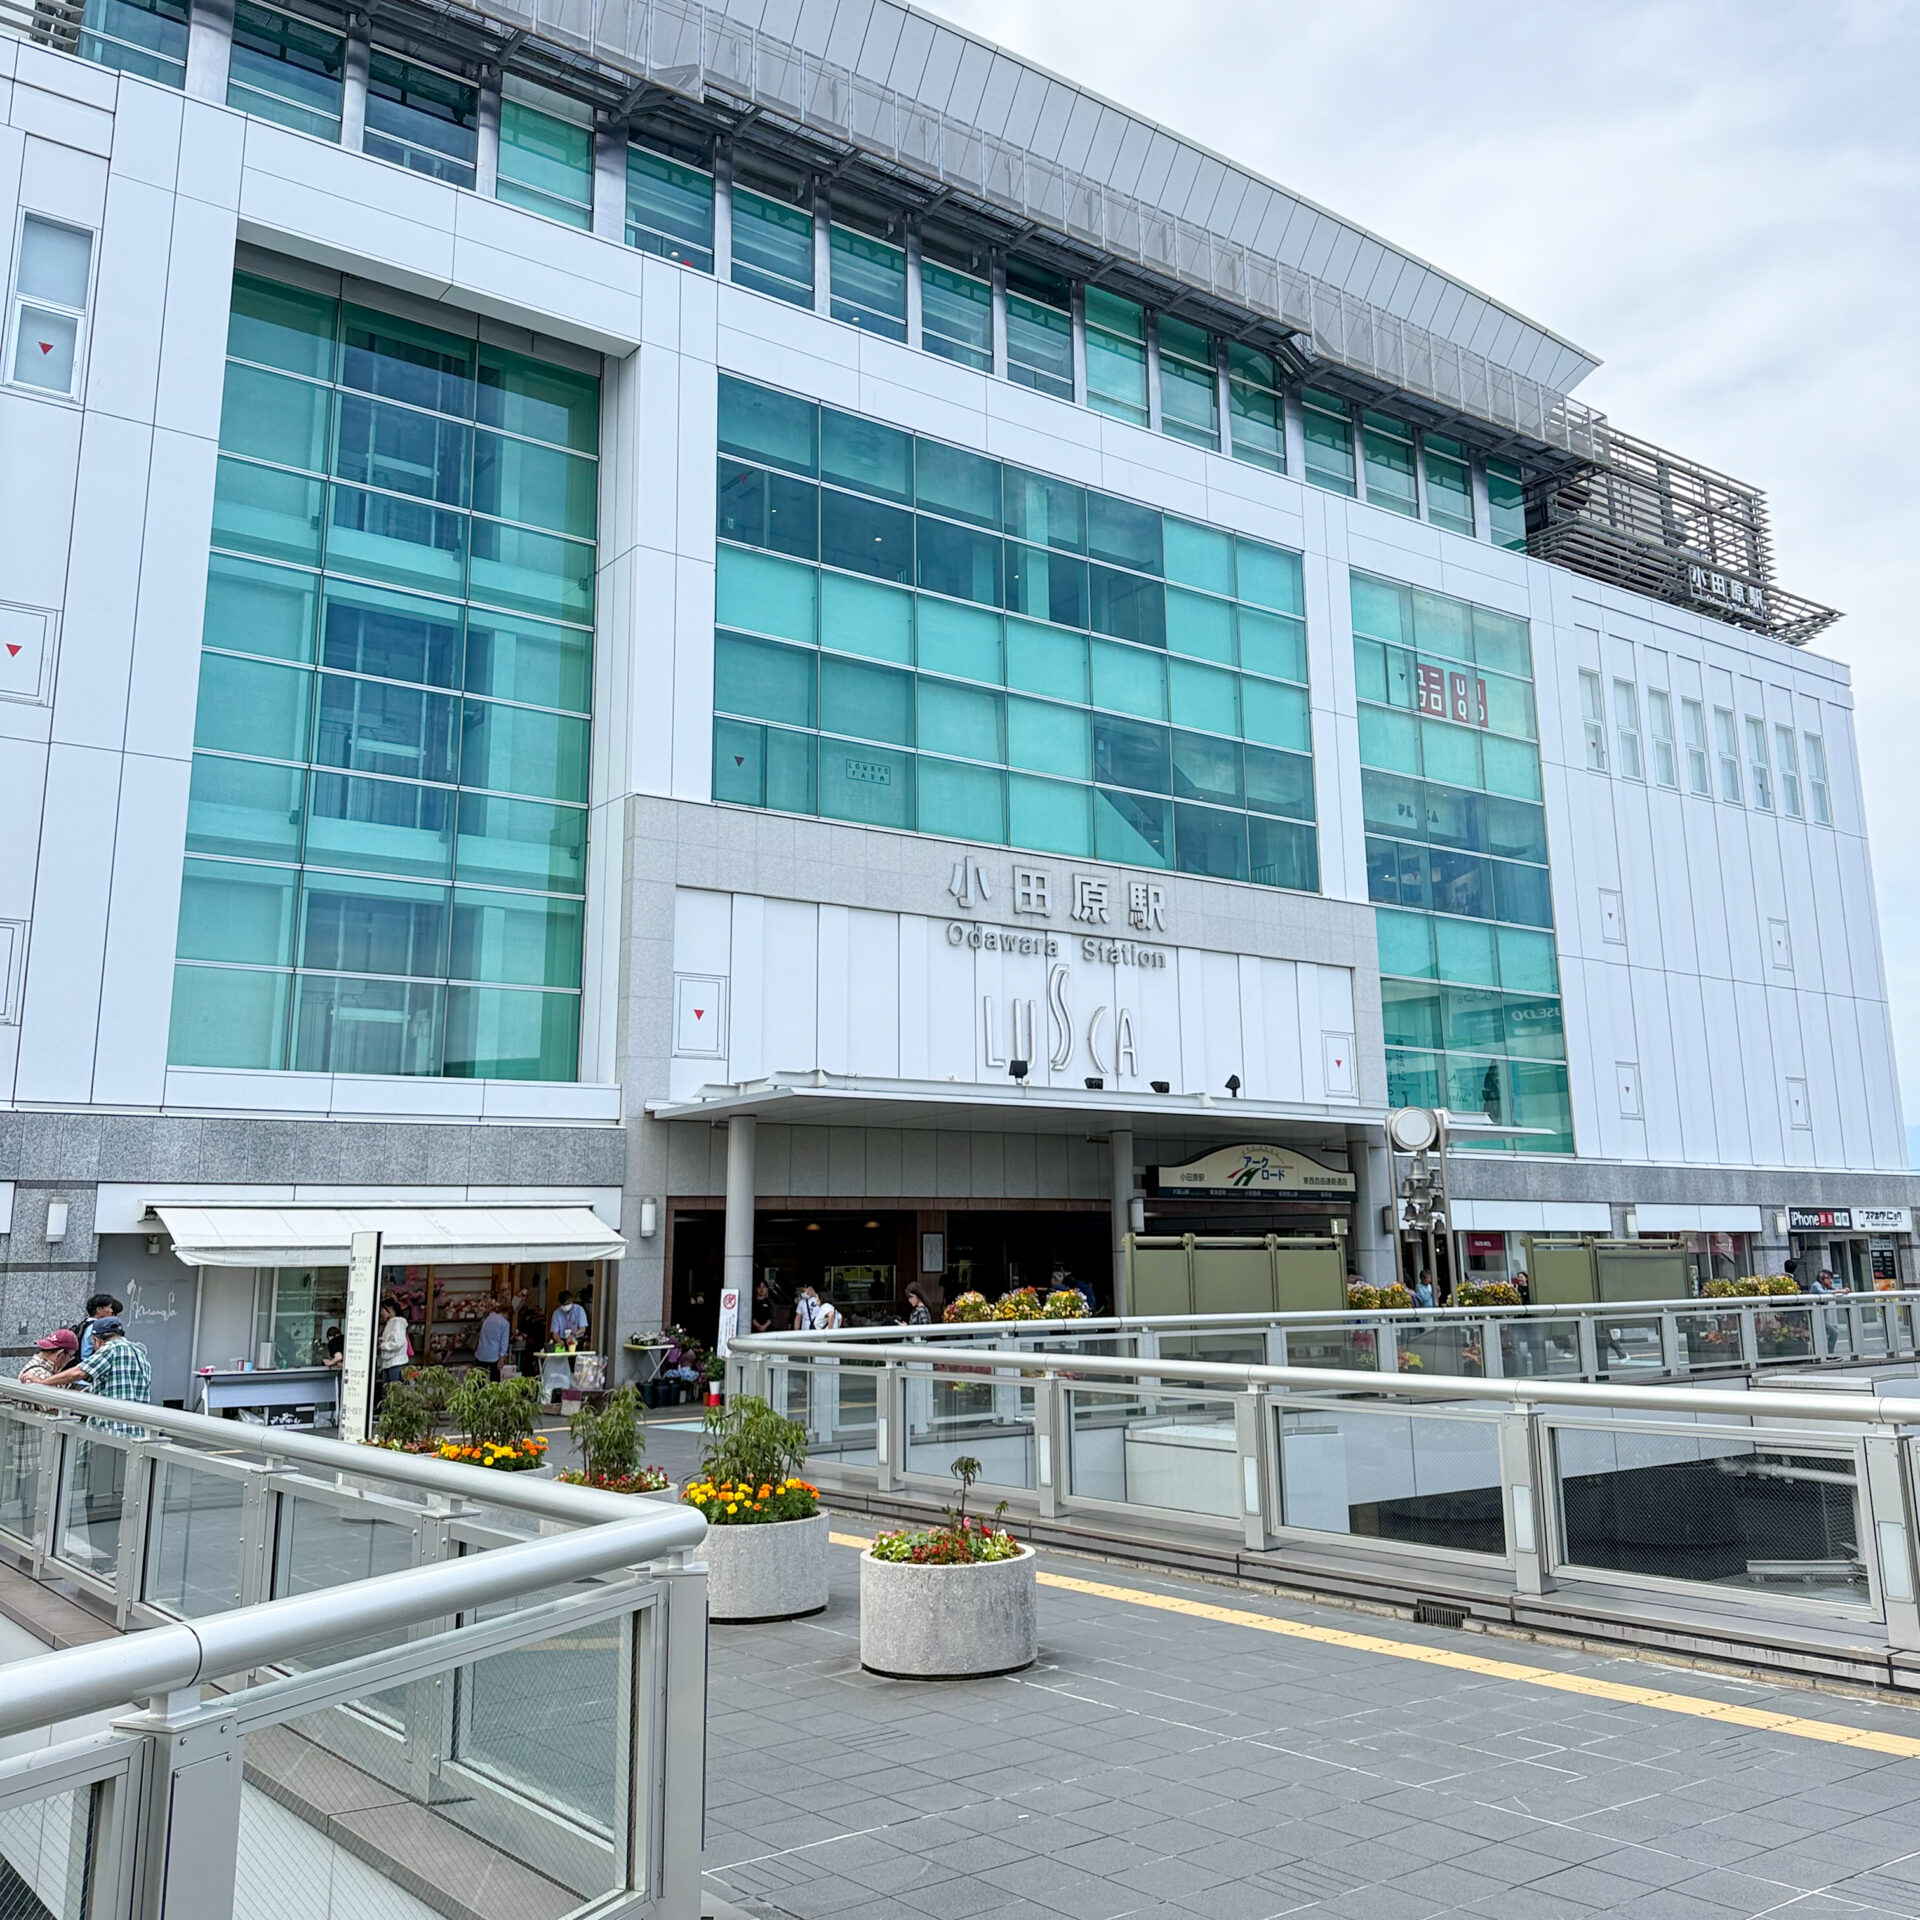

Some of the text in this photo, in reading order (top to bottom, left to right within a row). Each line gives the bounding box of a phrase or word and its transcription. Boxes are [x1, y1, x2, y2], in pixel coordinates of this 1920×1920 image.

[848, 762, 889, 775] LOWRYS
[852, 770, 885, 782] FARM
[948, 856, 1168, 932] 小田原駅
[947, 922, 1167, 969] Odawara Station
[983, 963, 1139, 1077] LUSCA
[1243, 1155, 1269, 1169] アーク
[1261, 1168, 1285, 1182] ロード
[1790, 1211, 1820, 1227] iPhone
